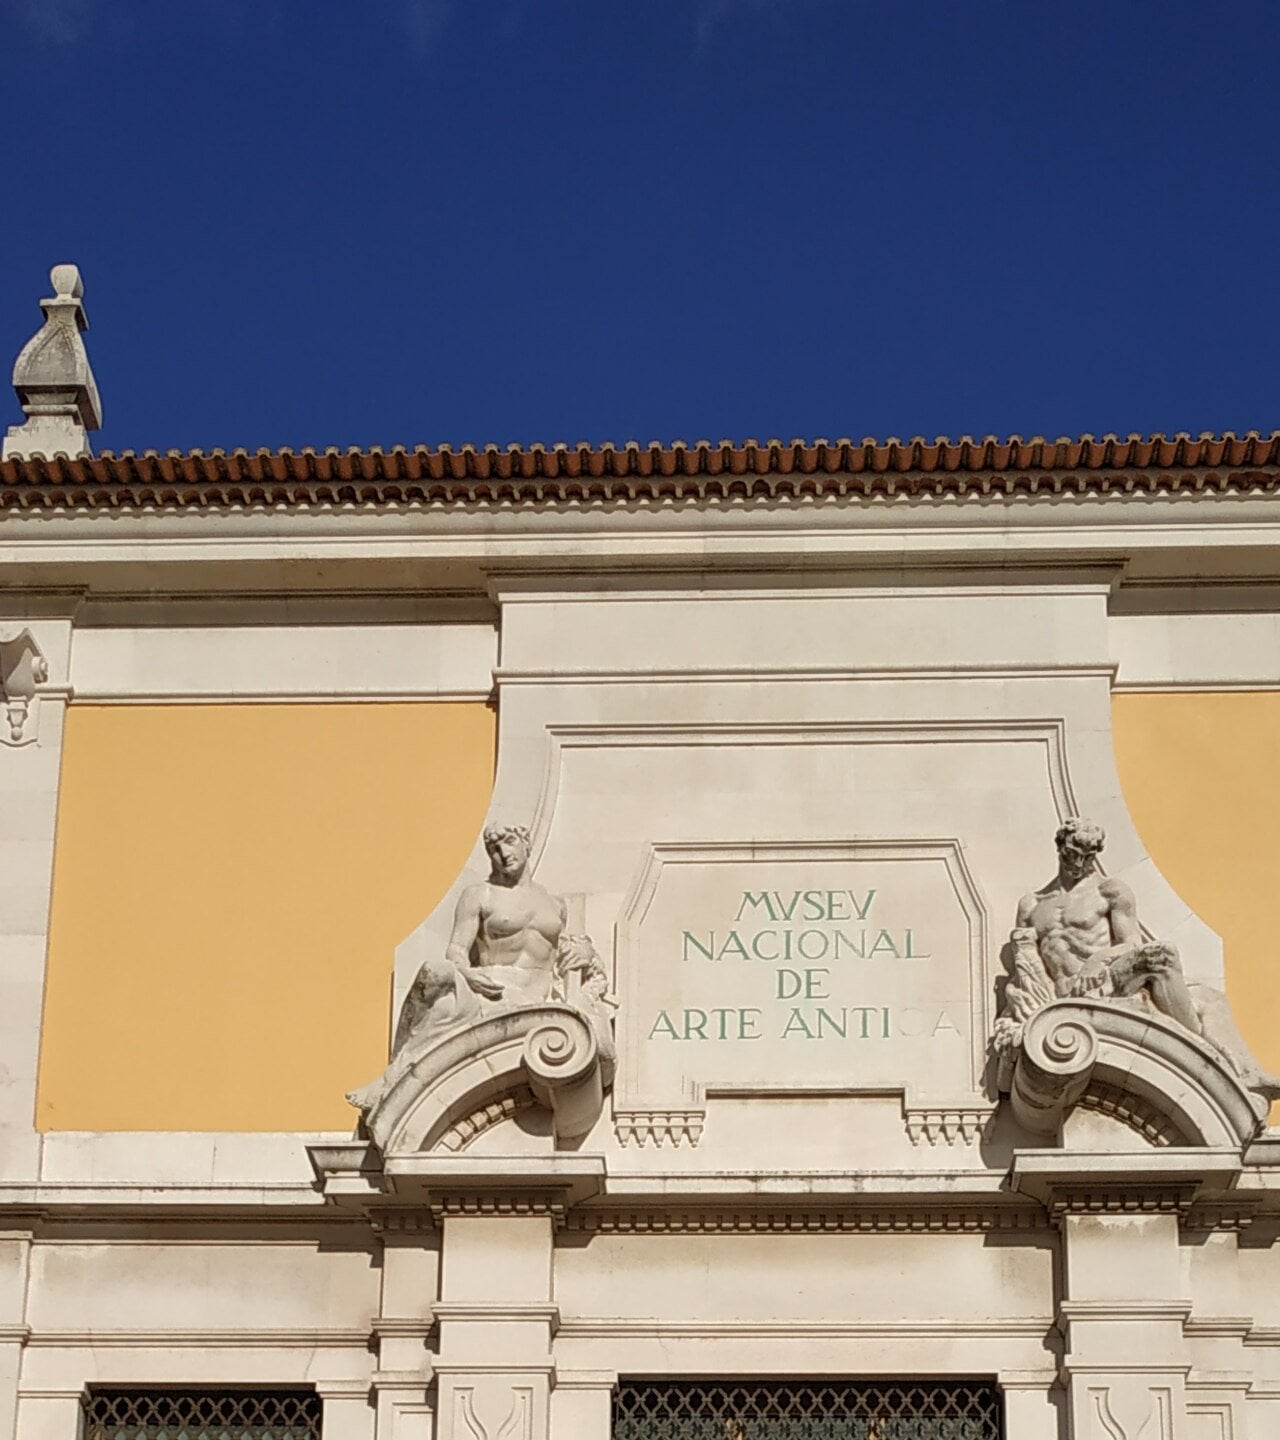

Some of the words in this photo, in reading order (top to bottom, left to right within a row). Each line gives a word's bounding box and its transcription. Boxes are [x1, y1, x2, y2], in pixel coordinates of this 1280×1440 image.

[681, 929, 932, 961] NACIONAL
[776, 968, 831, 1000] DE
[648, 1008, 763, 1041] ARTE
